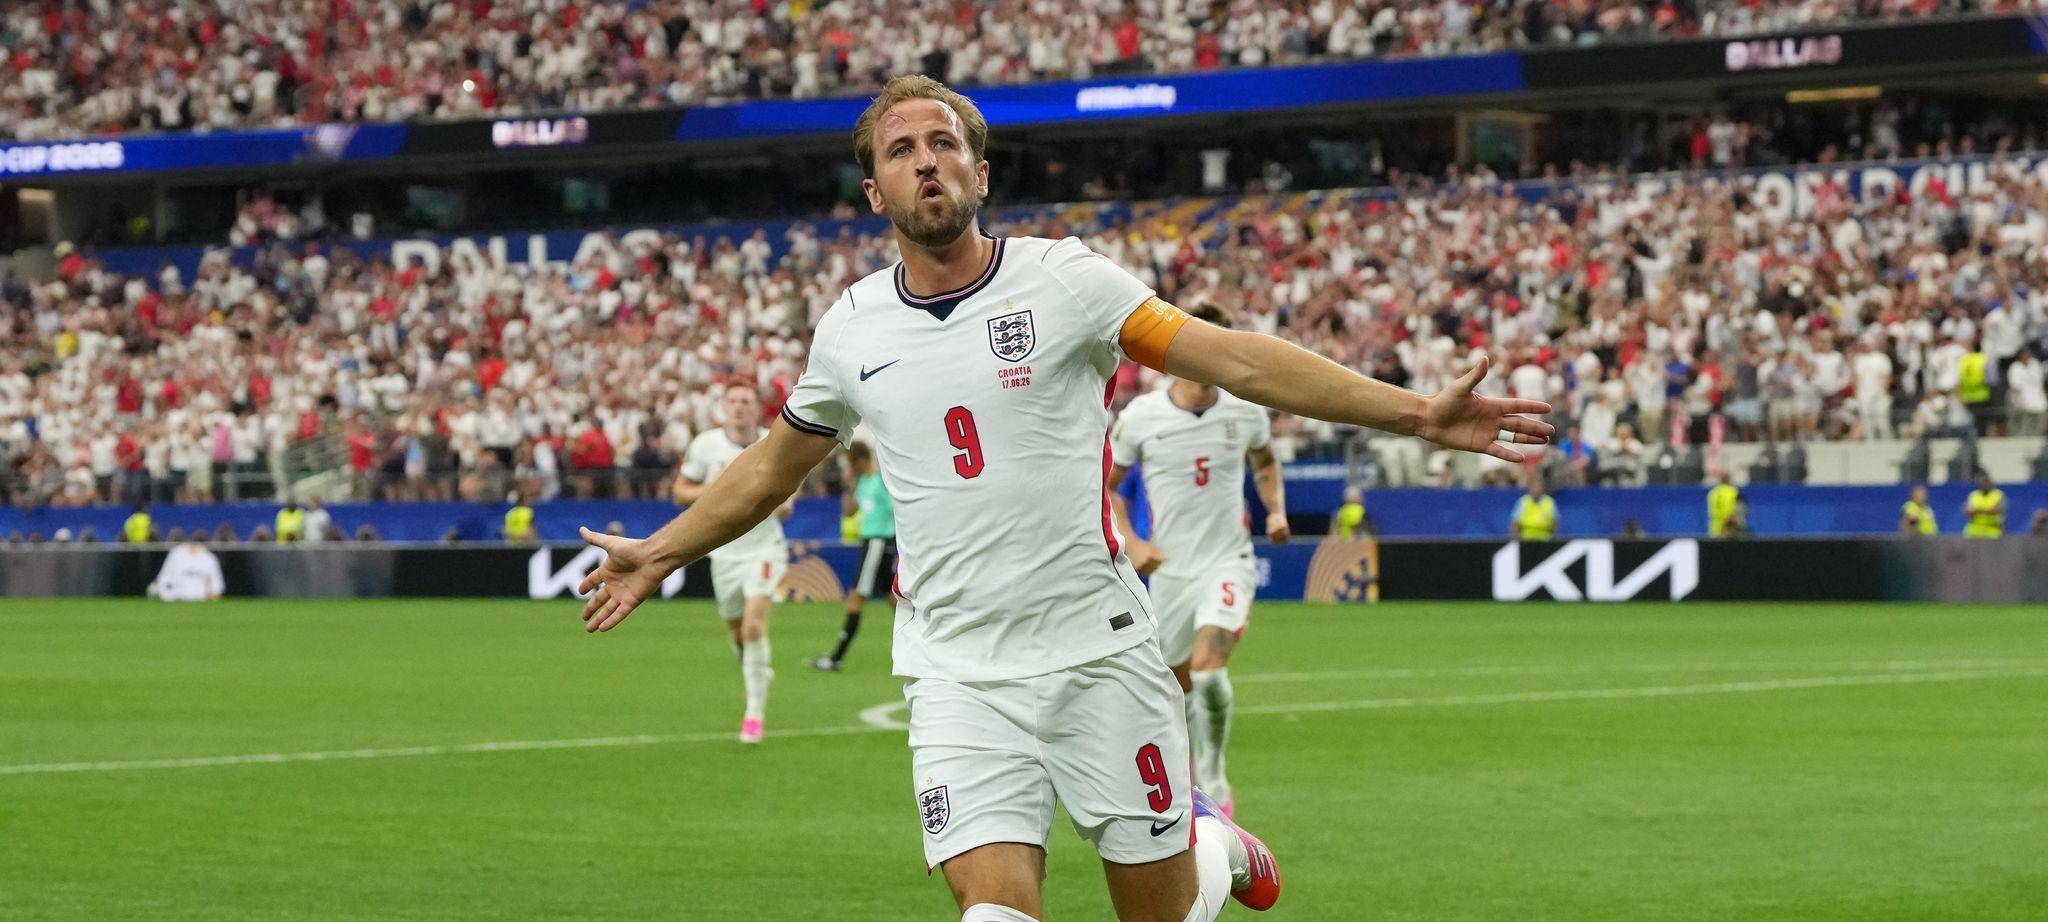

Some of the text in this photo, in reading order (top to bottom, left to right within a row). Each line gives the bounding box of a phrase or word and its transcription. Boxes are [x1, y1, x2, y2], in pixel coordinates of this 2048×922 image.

[49, 141, 125, 171] 2026
[997, 366, 1032, 378] CROATIA
[1002, 377, 1031, 389] 17.06.26
[944, 405, 984, 479] 9
[1195, 456, 1211, 487] 5
[1492, 538, 1699, 601] KIA
[1221, 582, 1236, 606] 5
[1135, 742, 1173, 814] 9
